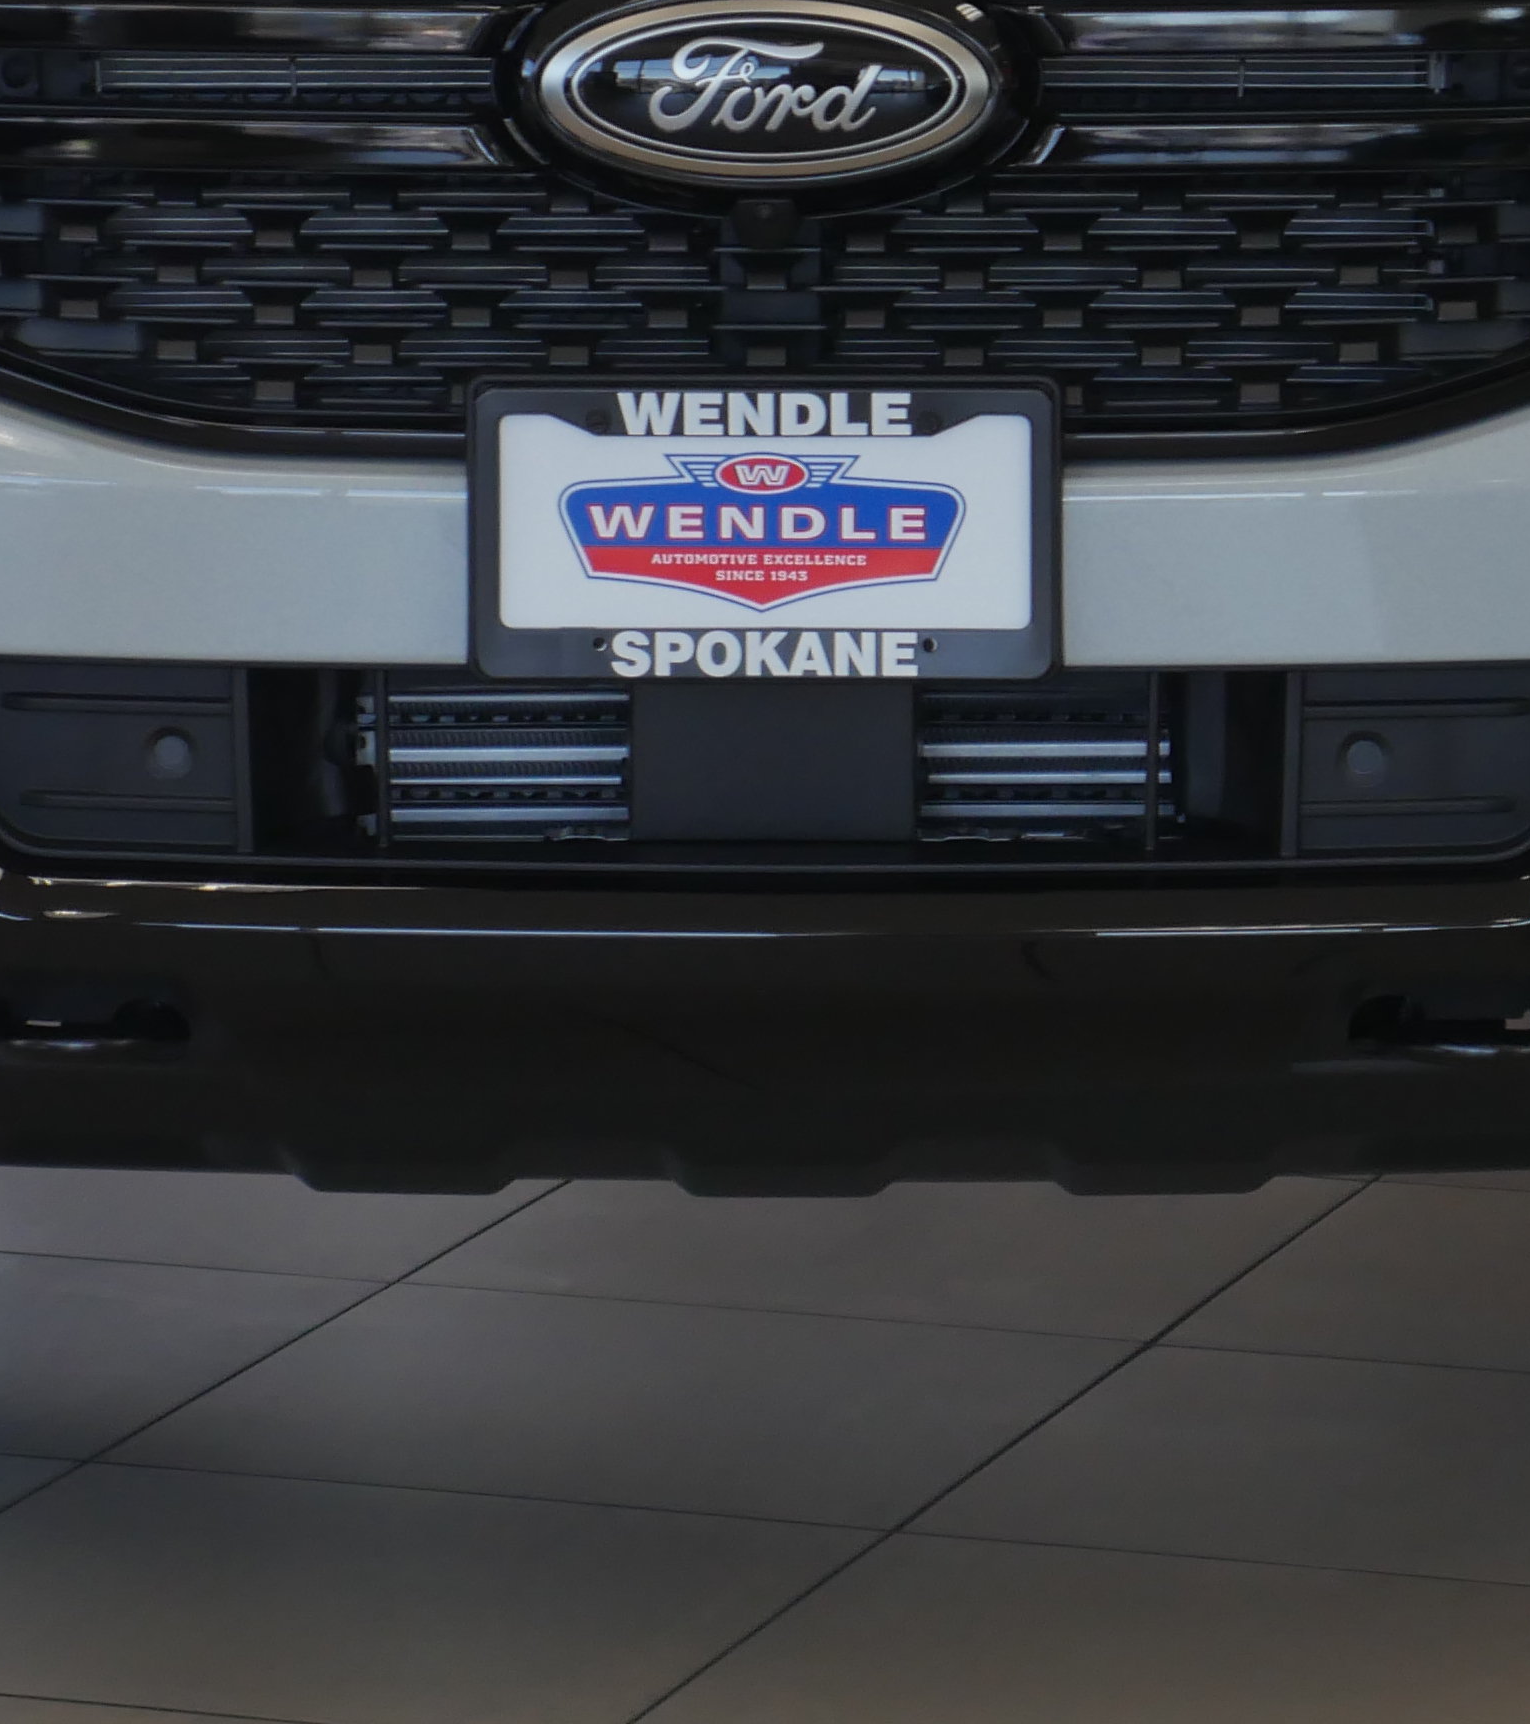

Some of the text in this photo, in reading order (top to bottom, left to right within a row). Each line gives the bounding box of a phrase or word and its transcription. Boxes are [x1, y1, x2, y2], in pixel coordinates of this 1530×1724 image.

[649, 37, 881, 132] Ford
[618, 392, 912, 435] WENDLE
[588, 505, 927, 540] WENDLE
[651, 554, 867, 566] AUTOMOTIVE EXCELLENCE
[715, 570, 808, 581] SINCE 1943
[611, 630, 919, 676] SPOKANE
